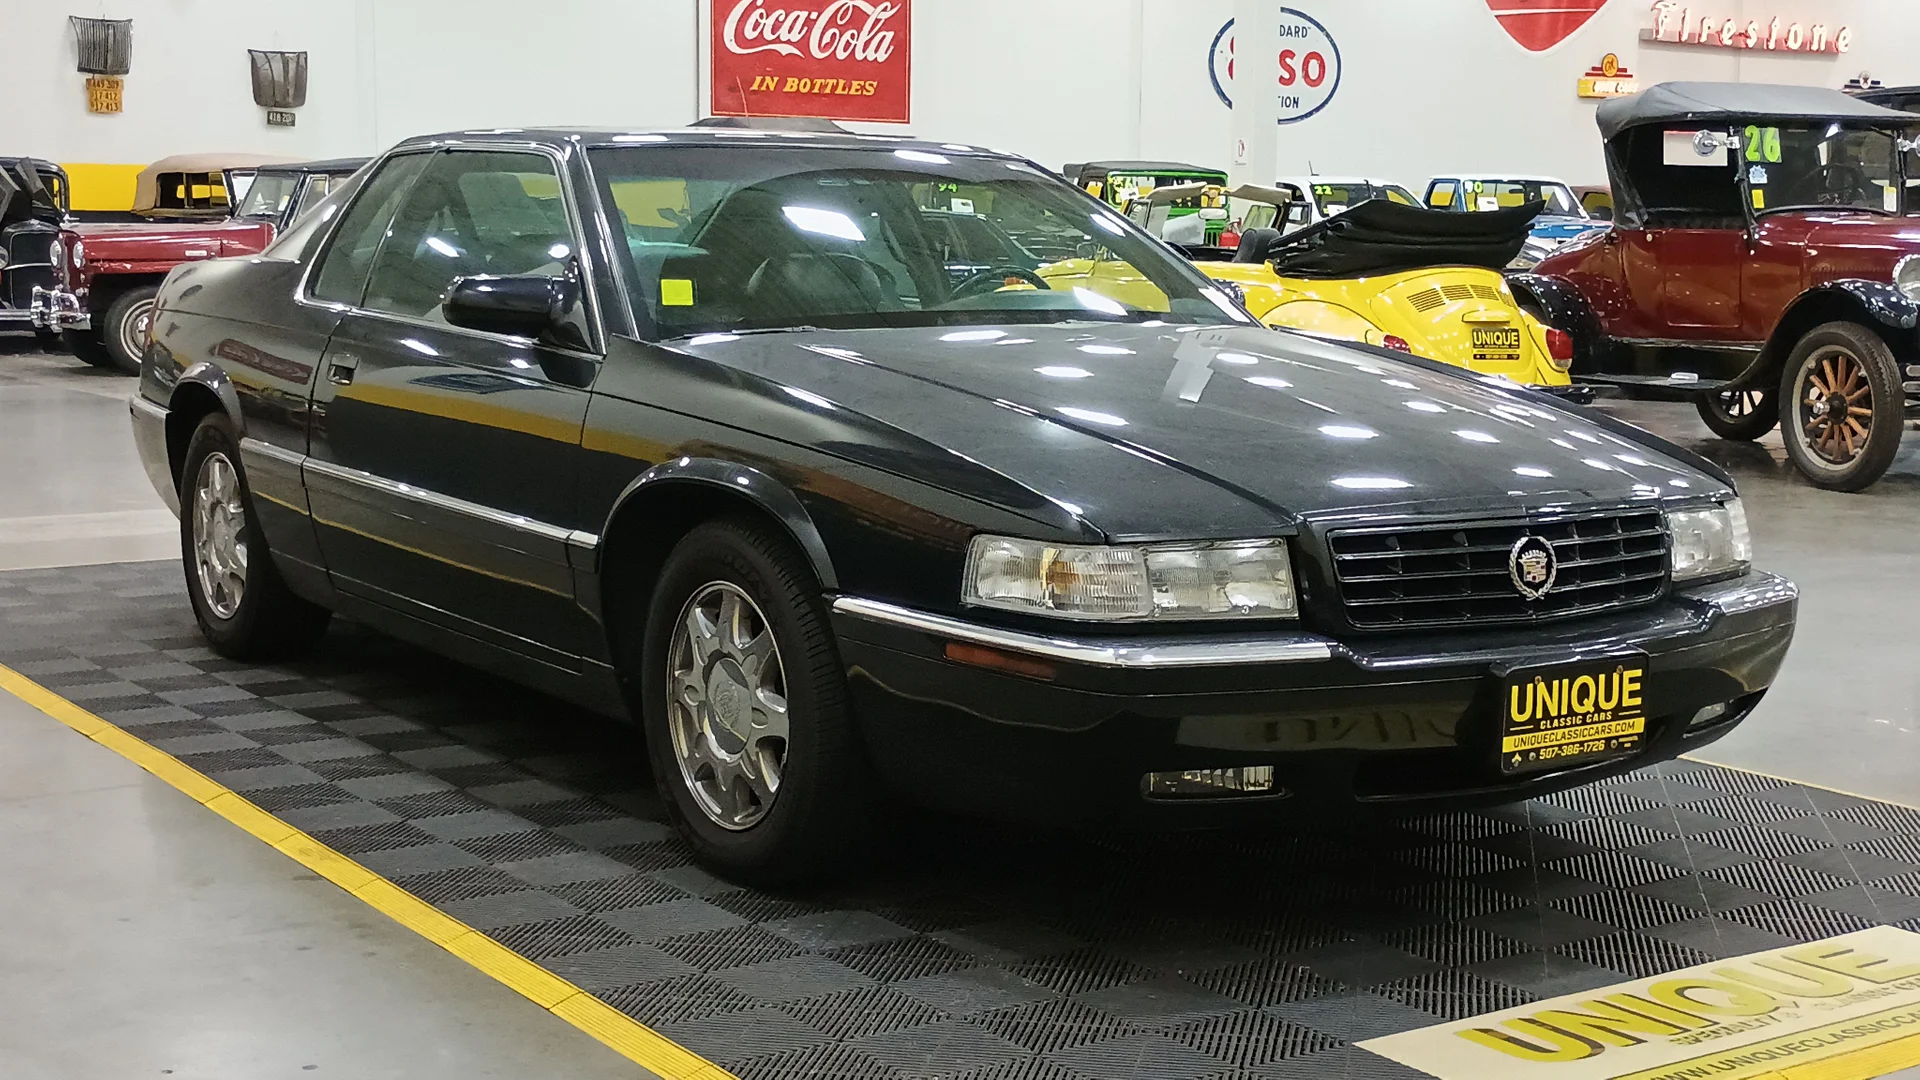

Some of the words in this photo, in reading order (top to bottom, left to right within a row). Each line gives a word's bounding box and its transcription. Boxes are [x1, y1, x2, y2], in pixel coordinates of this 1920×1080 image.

[723, 0, 902, 63] Coca-Cola
[1279, 25, 1308, 39] DARD
[1651, 0, 1851, 53] Firestone
[750, 76, 779, 91] IN
[783, 77, 878, 95] BOTTLES
[1278, 95, 1300, 109] ION
[1745, 125, 1780, 162] 26
[1473, 331, 1519, 345] UNIQUE
[1511, 669, 1643, 723] UNIQUE
[1540, 715, 1583, 730] CLASSIC
[1586, 711, 1612, 723] CARS
[1513, 721, 1636, 749] UNIQUECLASSICCARS.COM
[1539, 740, 1606, 760] 507-386-1726
[1454, 944, 1920, 1063] UNIQUE
